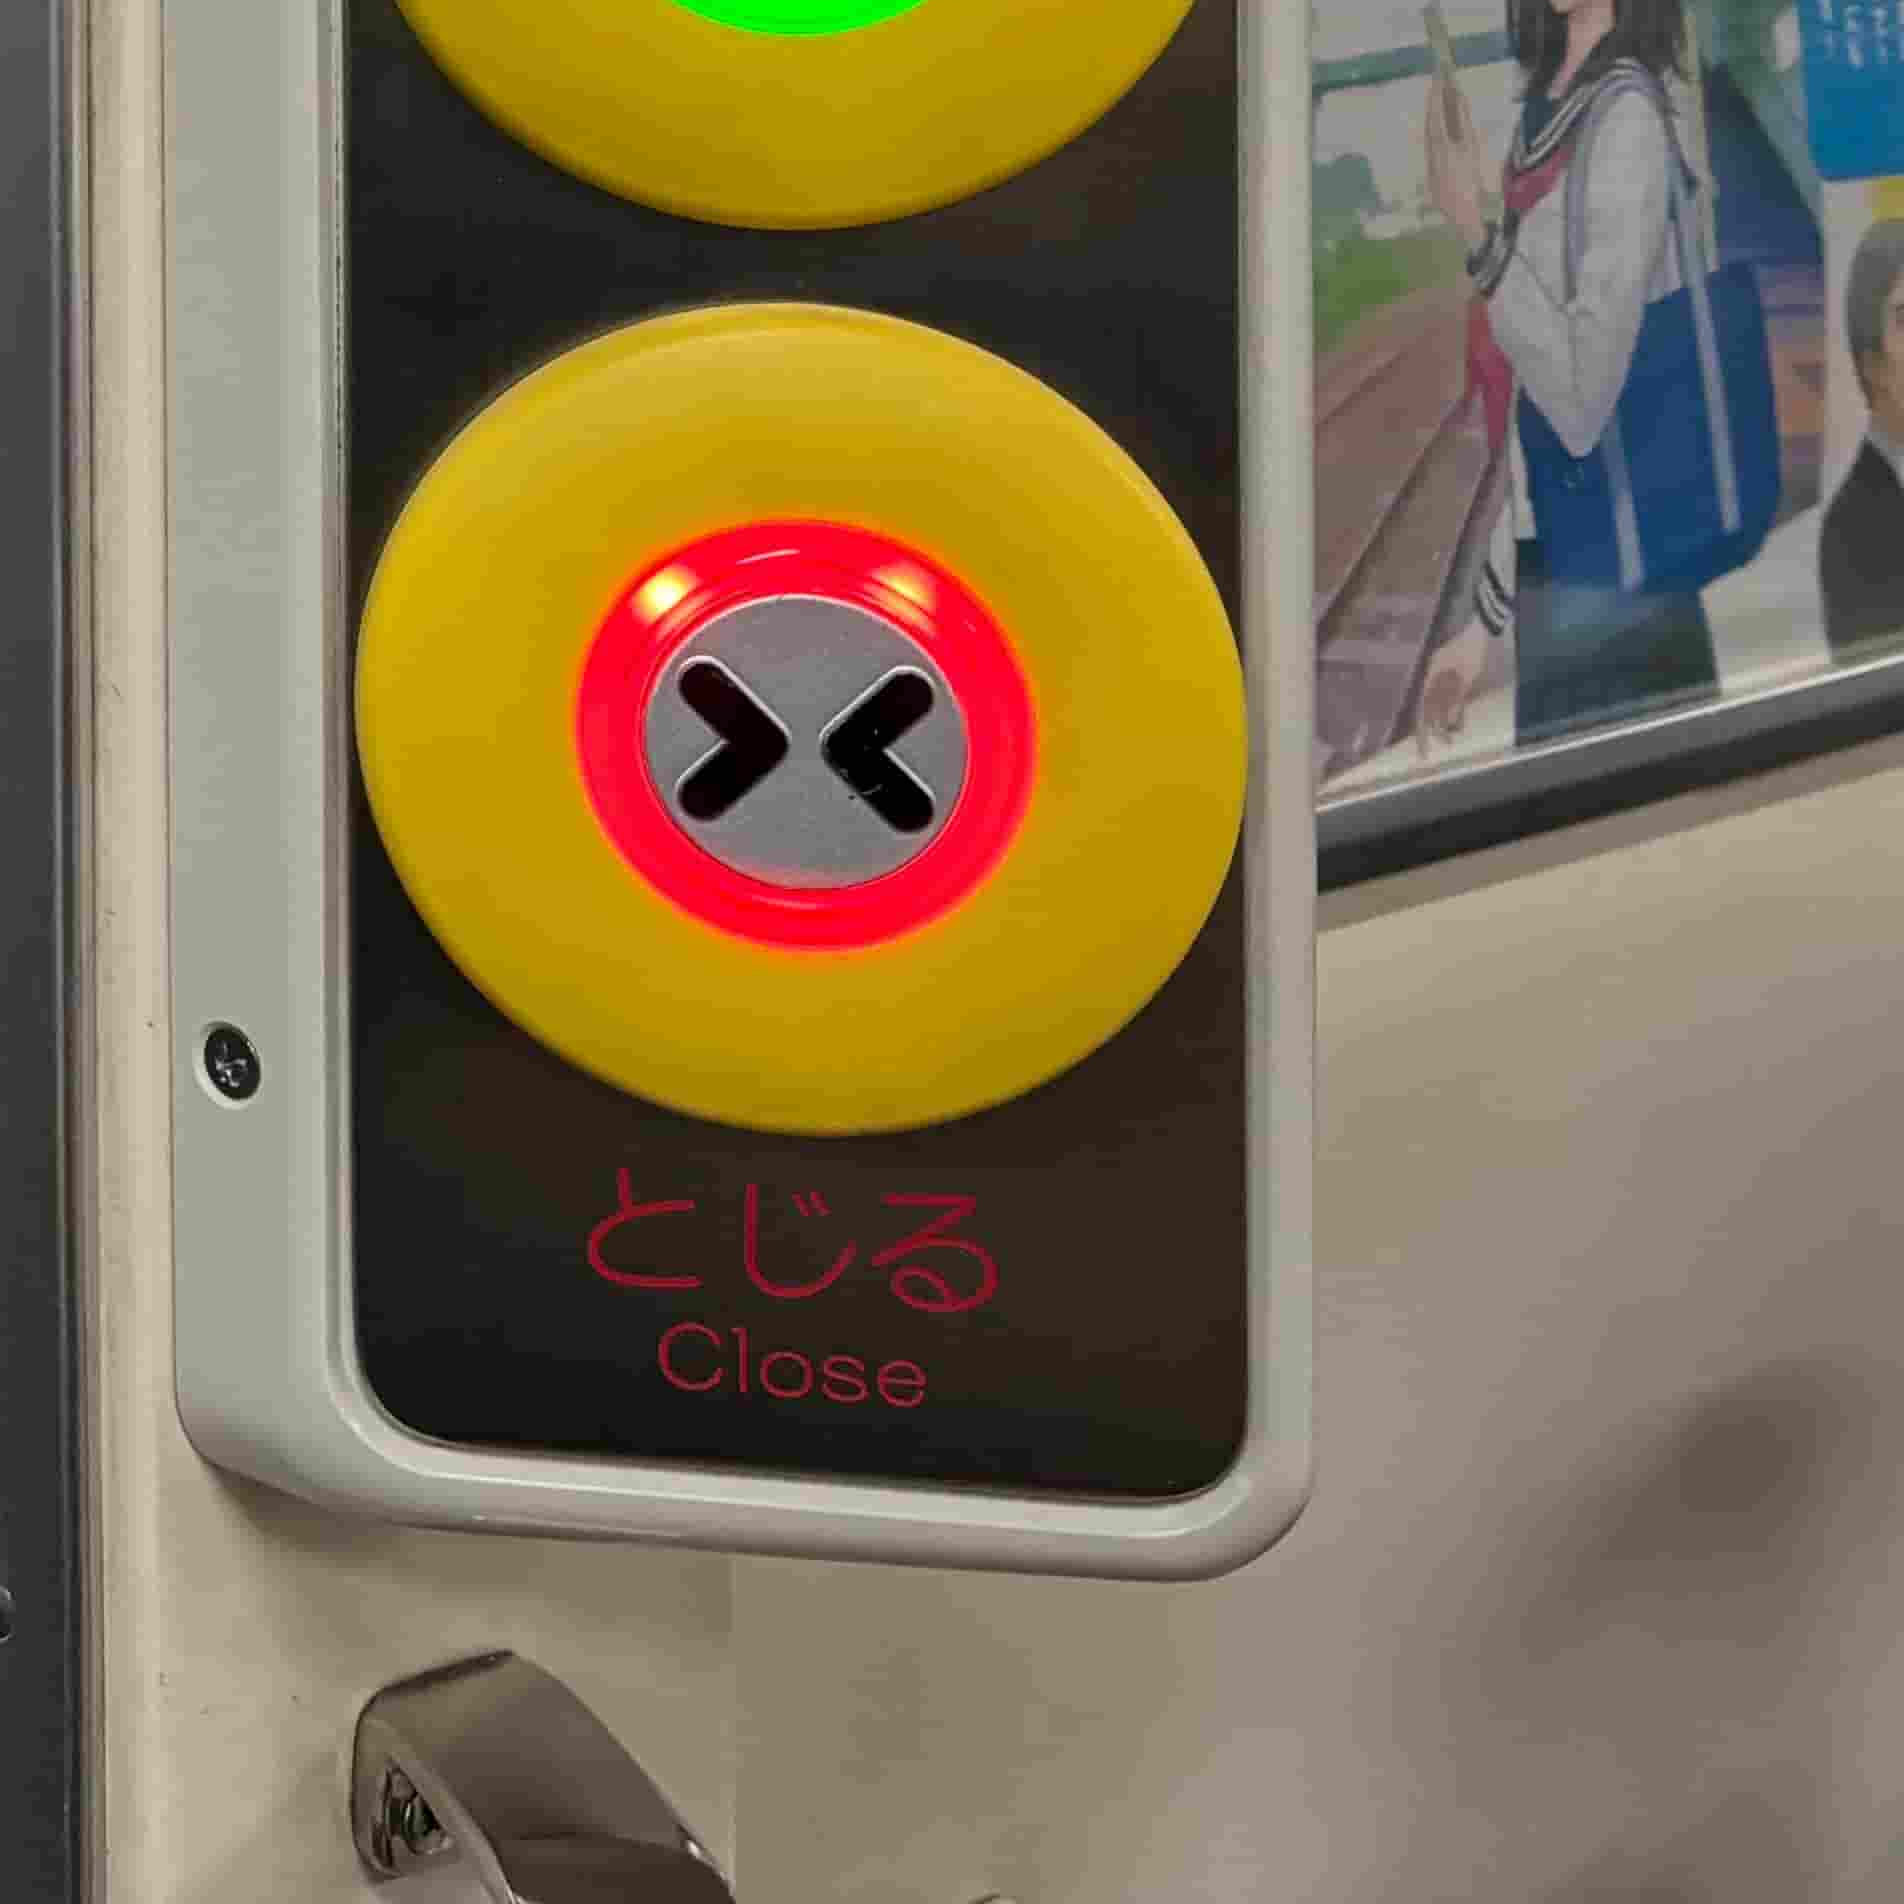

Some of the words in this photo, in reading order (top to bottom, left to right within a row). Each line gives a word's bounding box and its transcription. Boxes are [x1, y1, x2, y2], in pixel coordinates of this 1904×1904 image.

[586, 1166, 999, 1313] とじる
[656, 1321, 928, 1408] Close
